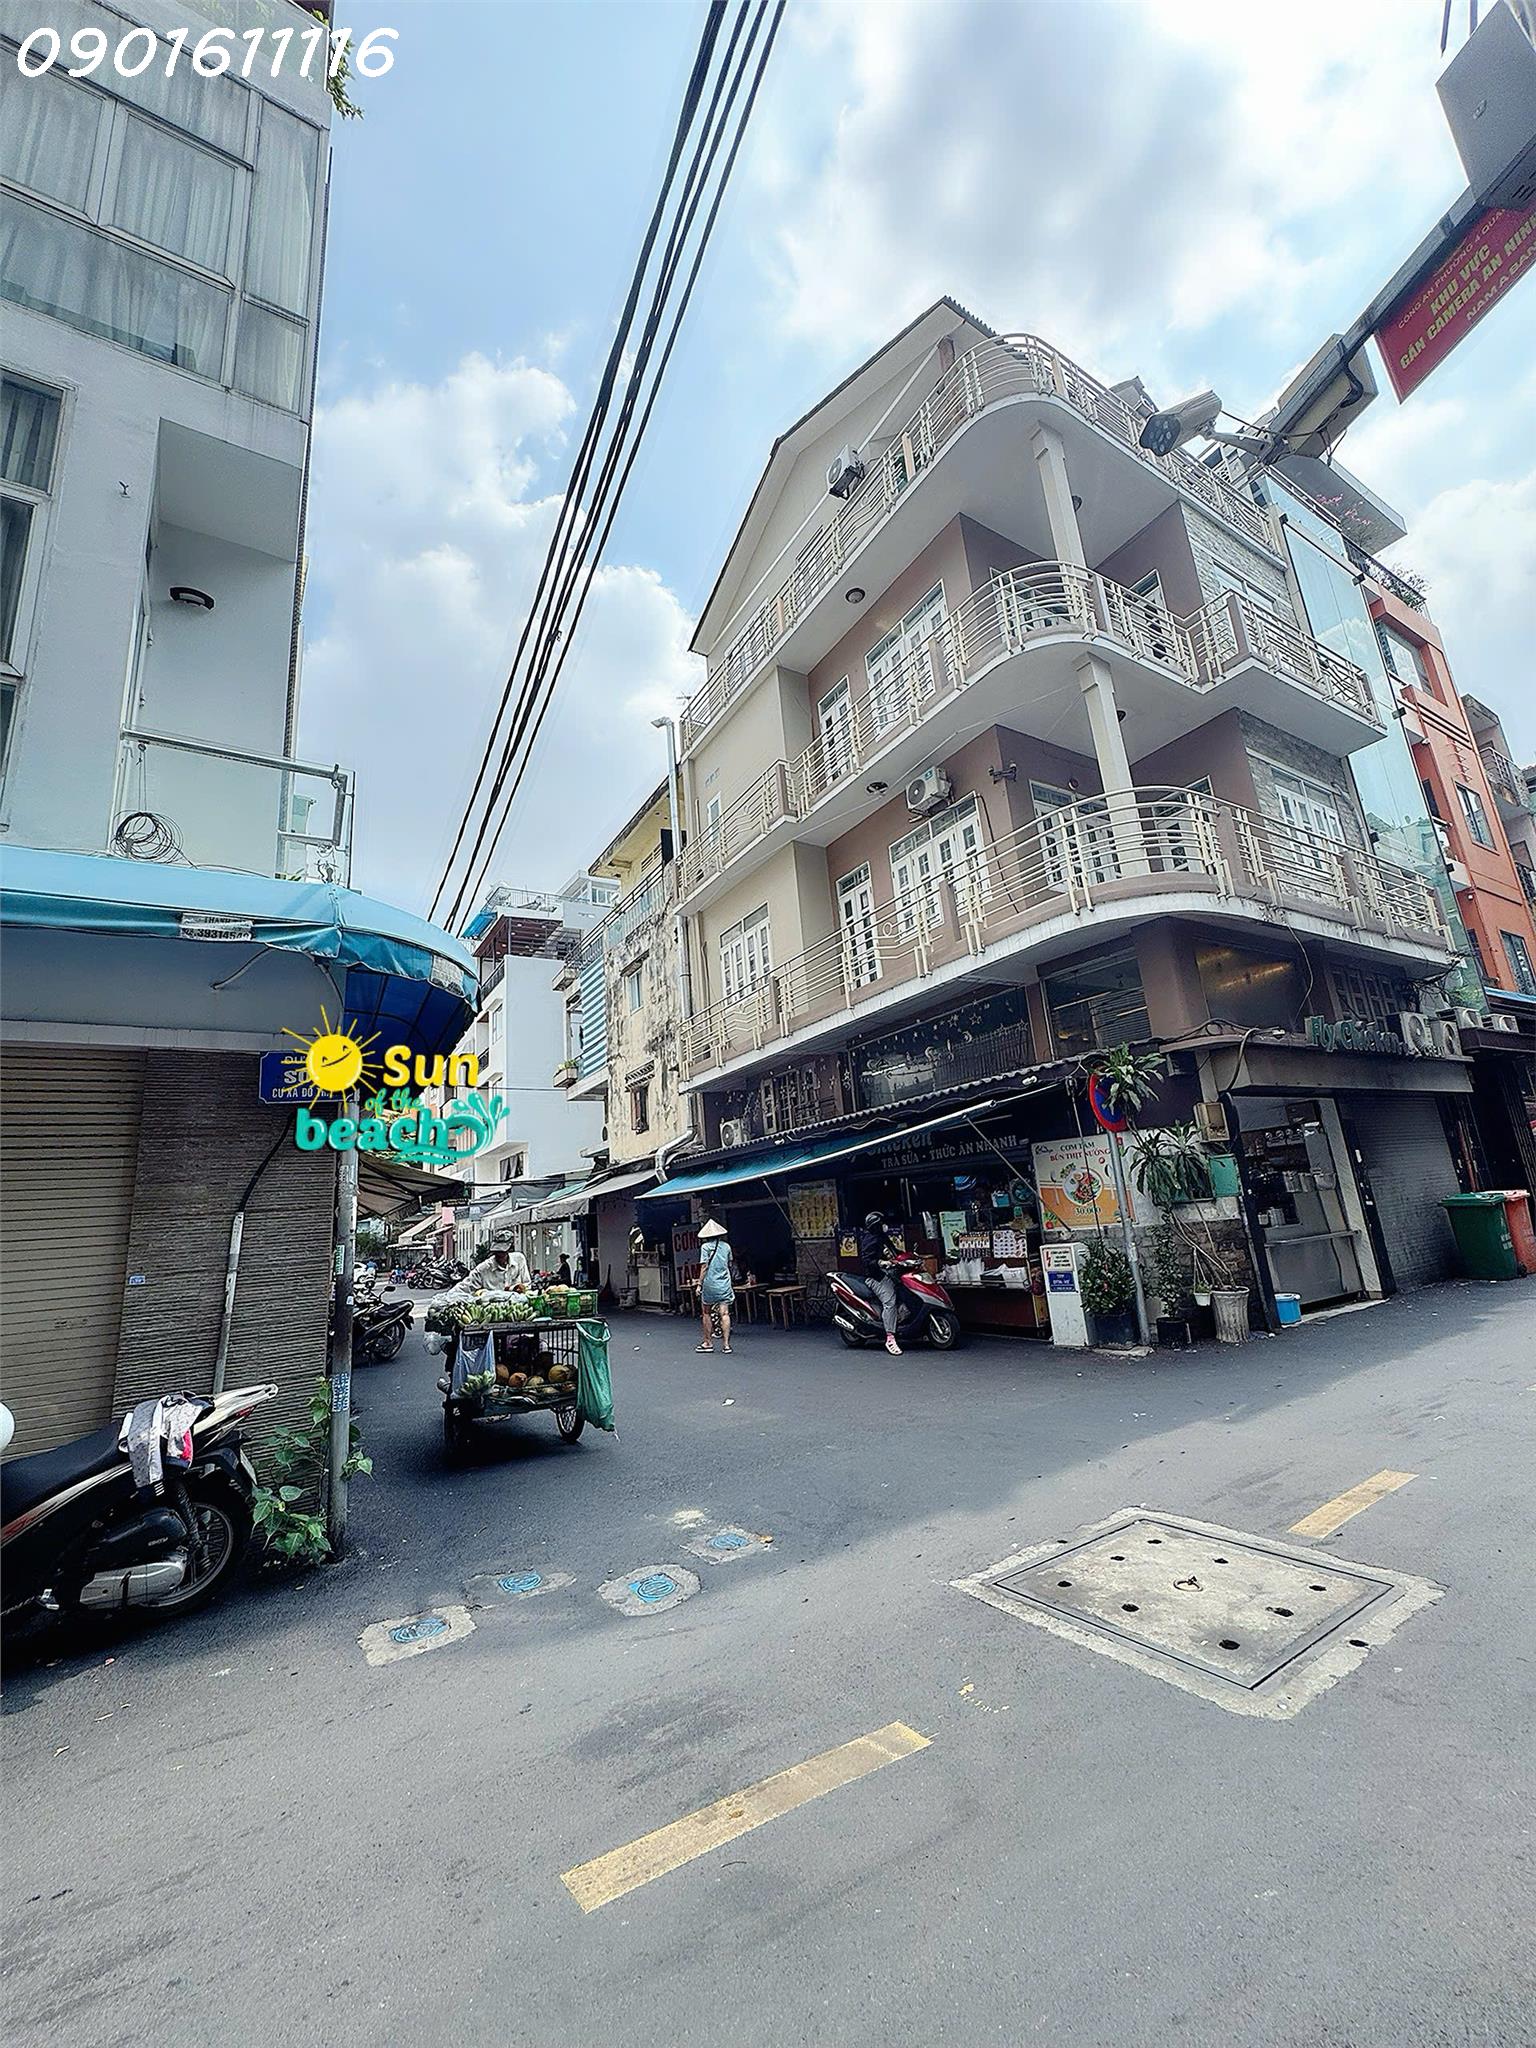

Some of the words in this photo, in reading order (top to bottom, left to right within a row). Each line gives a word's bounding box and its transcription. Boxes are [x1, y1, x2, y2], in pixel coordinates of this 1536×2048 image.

[1426, 279, 1481, 340] CAMERA
[1482, 253, 1503, 282] AN
[1431, 278, 1459, 316] KHU
